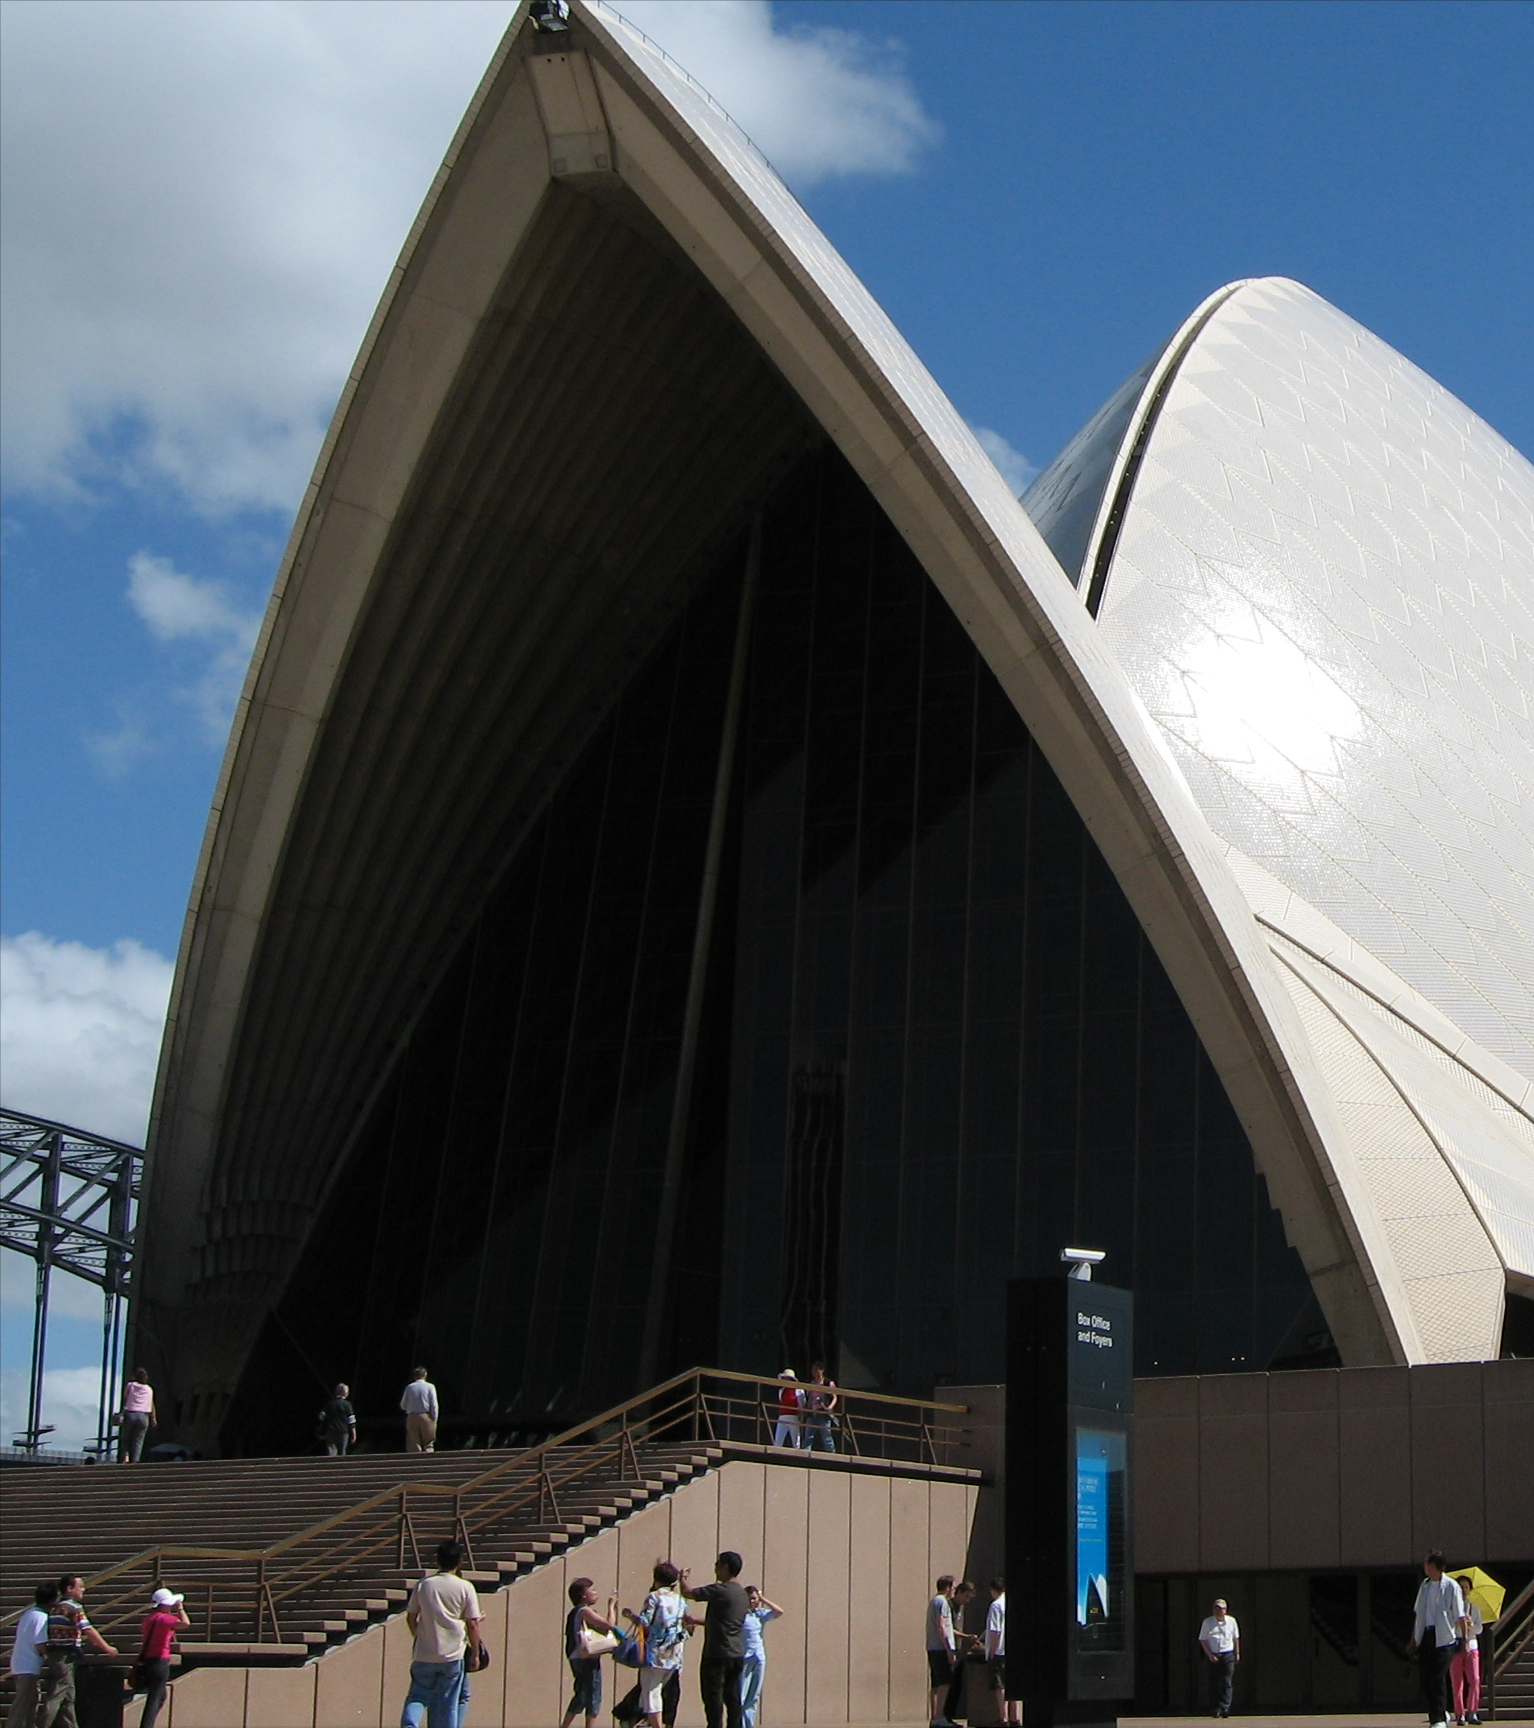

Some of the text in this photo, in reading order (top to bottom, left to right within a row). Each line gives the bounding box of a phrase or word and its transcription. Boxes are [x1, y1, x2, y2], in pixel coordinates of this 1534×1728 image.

[1077, 1312, 1111, 1330] Box Office
[1077, 1331, 1113, 1348] and Foyers
